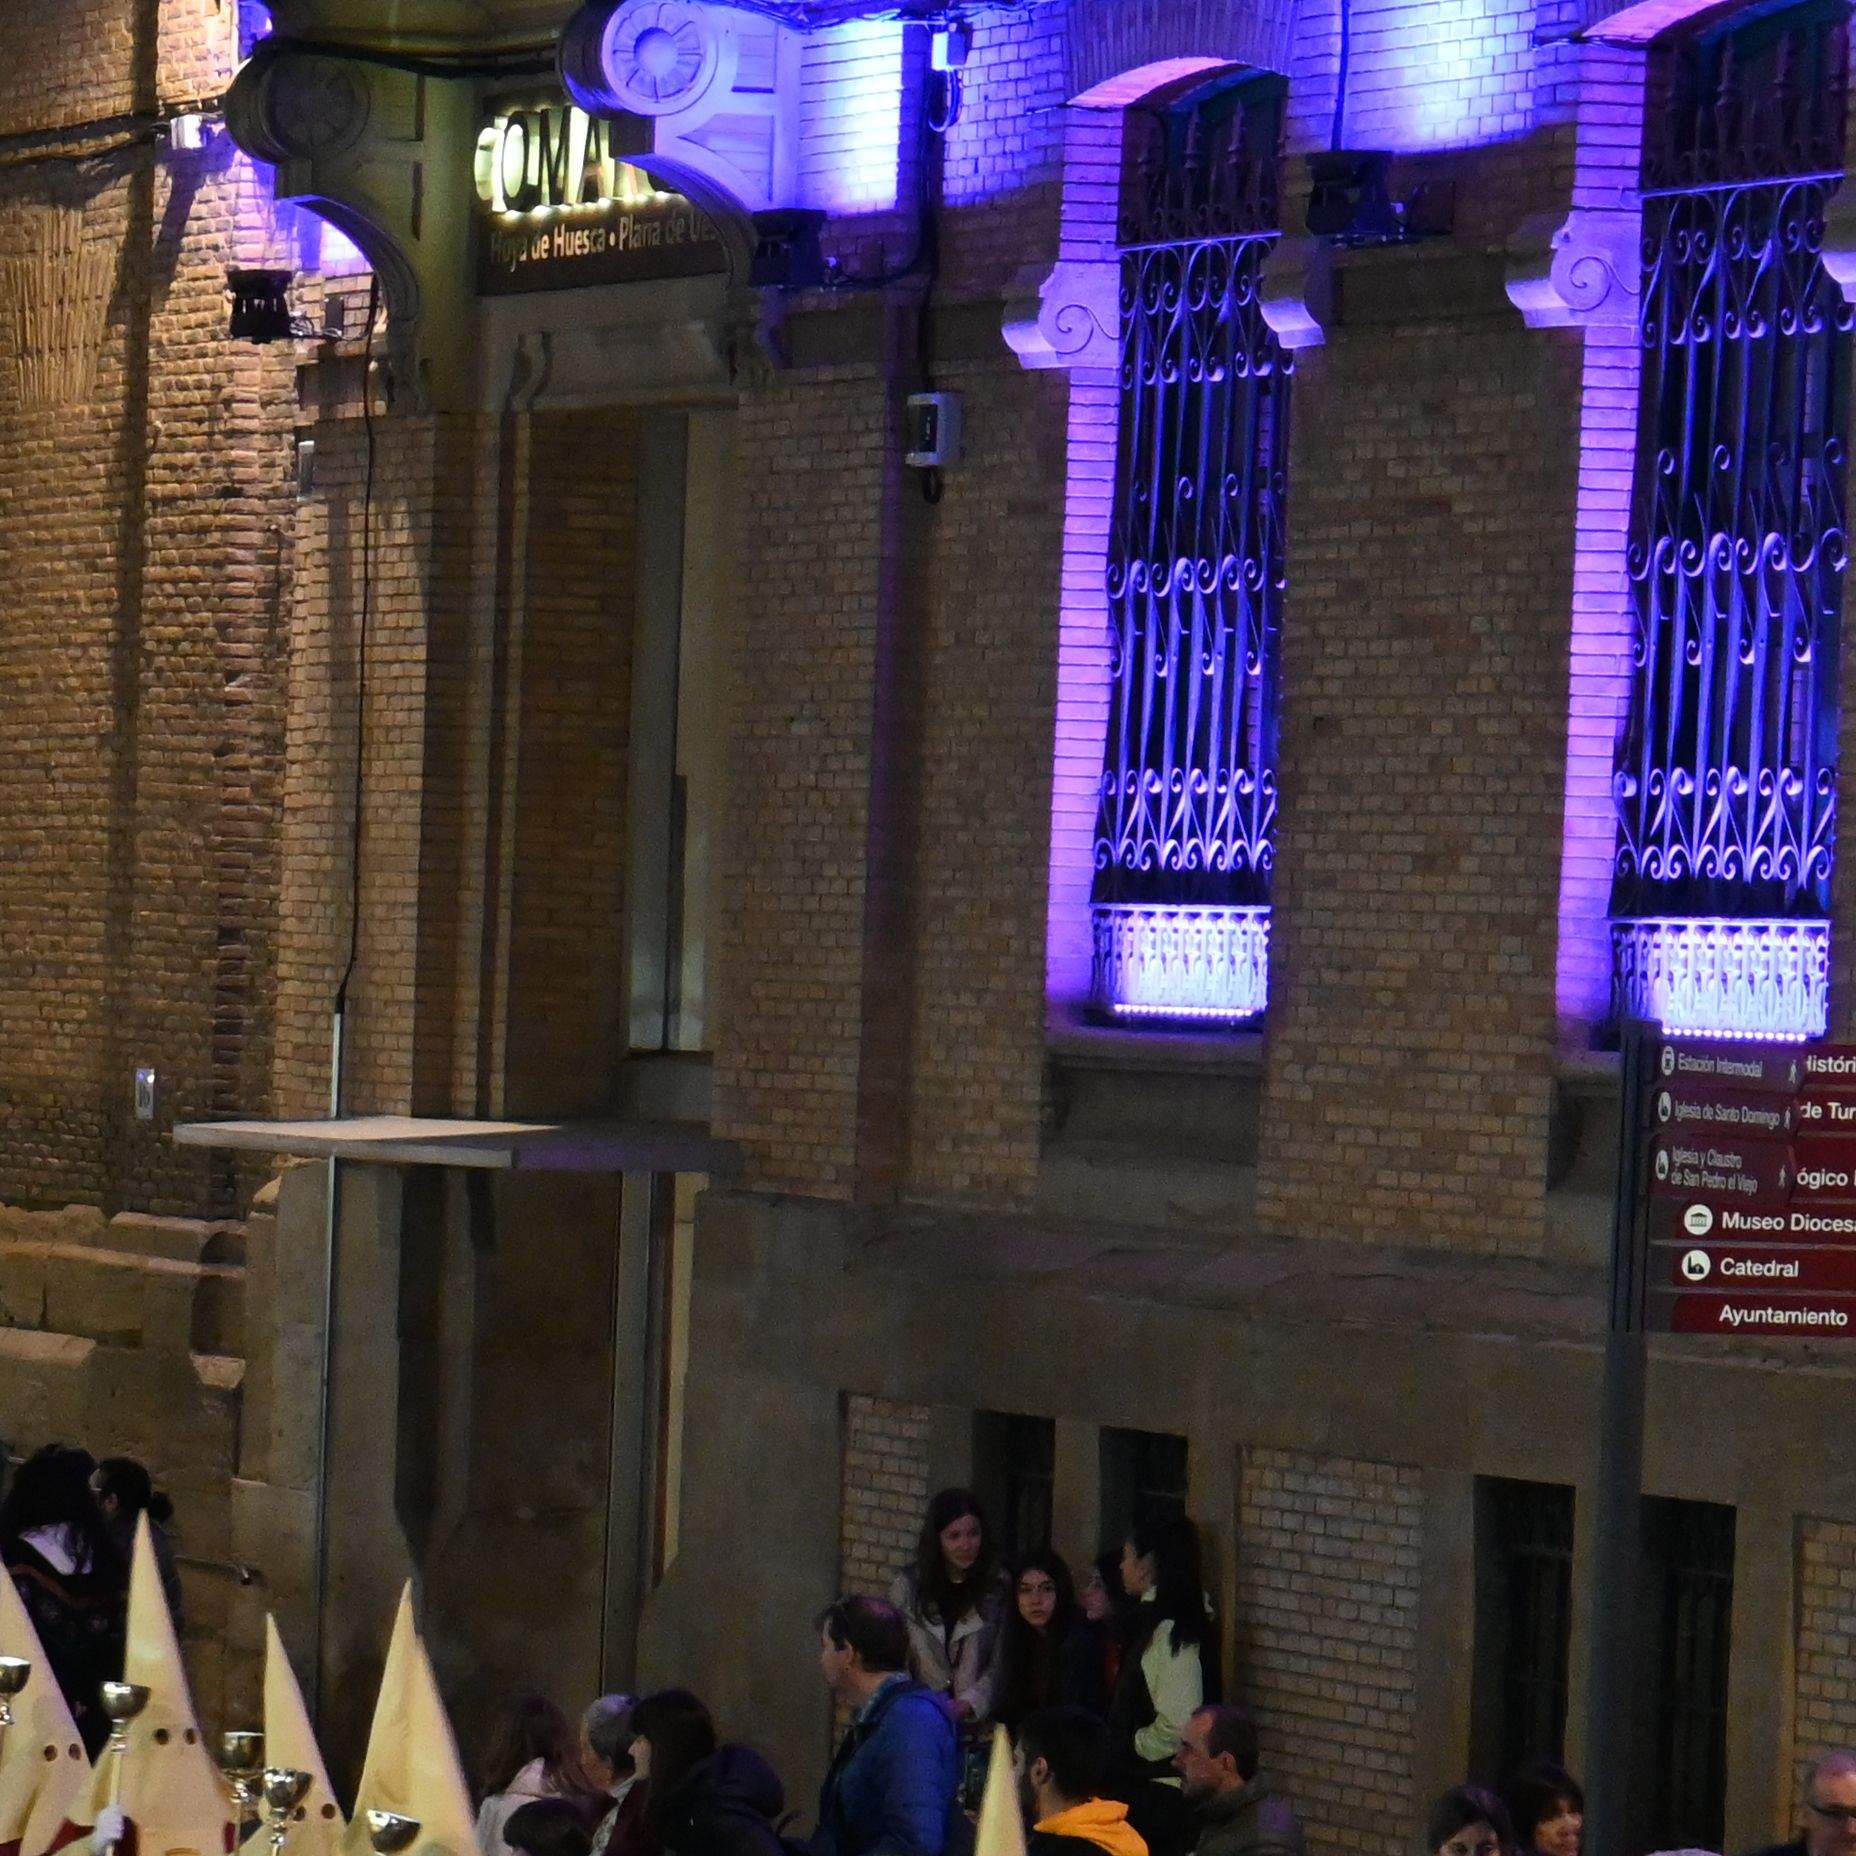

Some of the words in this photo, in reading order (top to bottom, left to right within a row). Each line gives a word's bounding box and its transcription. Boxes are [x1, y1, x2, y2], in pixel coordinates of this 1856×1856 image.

[553, 223, 606, 258] Huesca
[618, 213, 662, 251] Plana
[665, 209, 685, 245] de
[1678, 1052, 1715, 1073] Estación
[1716, 1056, 1763, 1078] Intermodal
[1674, 1099, 1702, 1122] Iglesia
[1702, 1104, 1714, 1120] de
[1715, 1103, 1740, 1122] Santo
[1741, 1105, 1781, 1130] Domingo
[1800, 1101, 1822, 1119] de
[1827, 1101, 1856, 1120] Tur
[1672, 1145, 1699, 1168] Iglesia
[1707, 1148, 1742, 1169] Claustro
[1670, 1168, 1682, 1185] de
[1683, 1168, 1700, 1187] San
[1702, 1171, 1726, 1190] Pedro
[1727, 1173, 1736, 1190] el
[1737, 1173, 1759, 1196] Viejo
[1796, 1167, 1848, 1189] ógico
[1722, 1211, 1785, 1231] Museo
[1720, 1257, 1800, 1278] Catedral
[1719, 1304, 1848, 1326] Ayuntamiento
